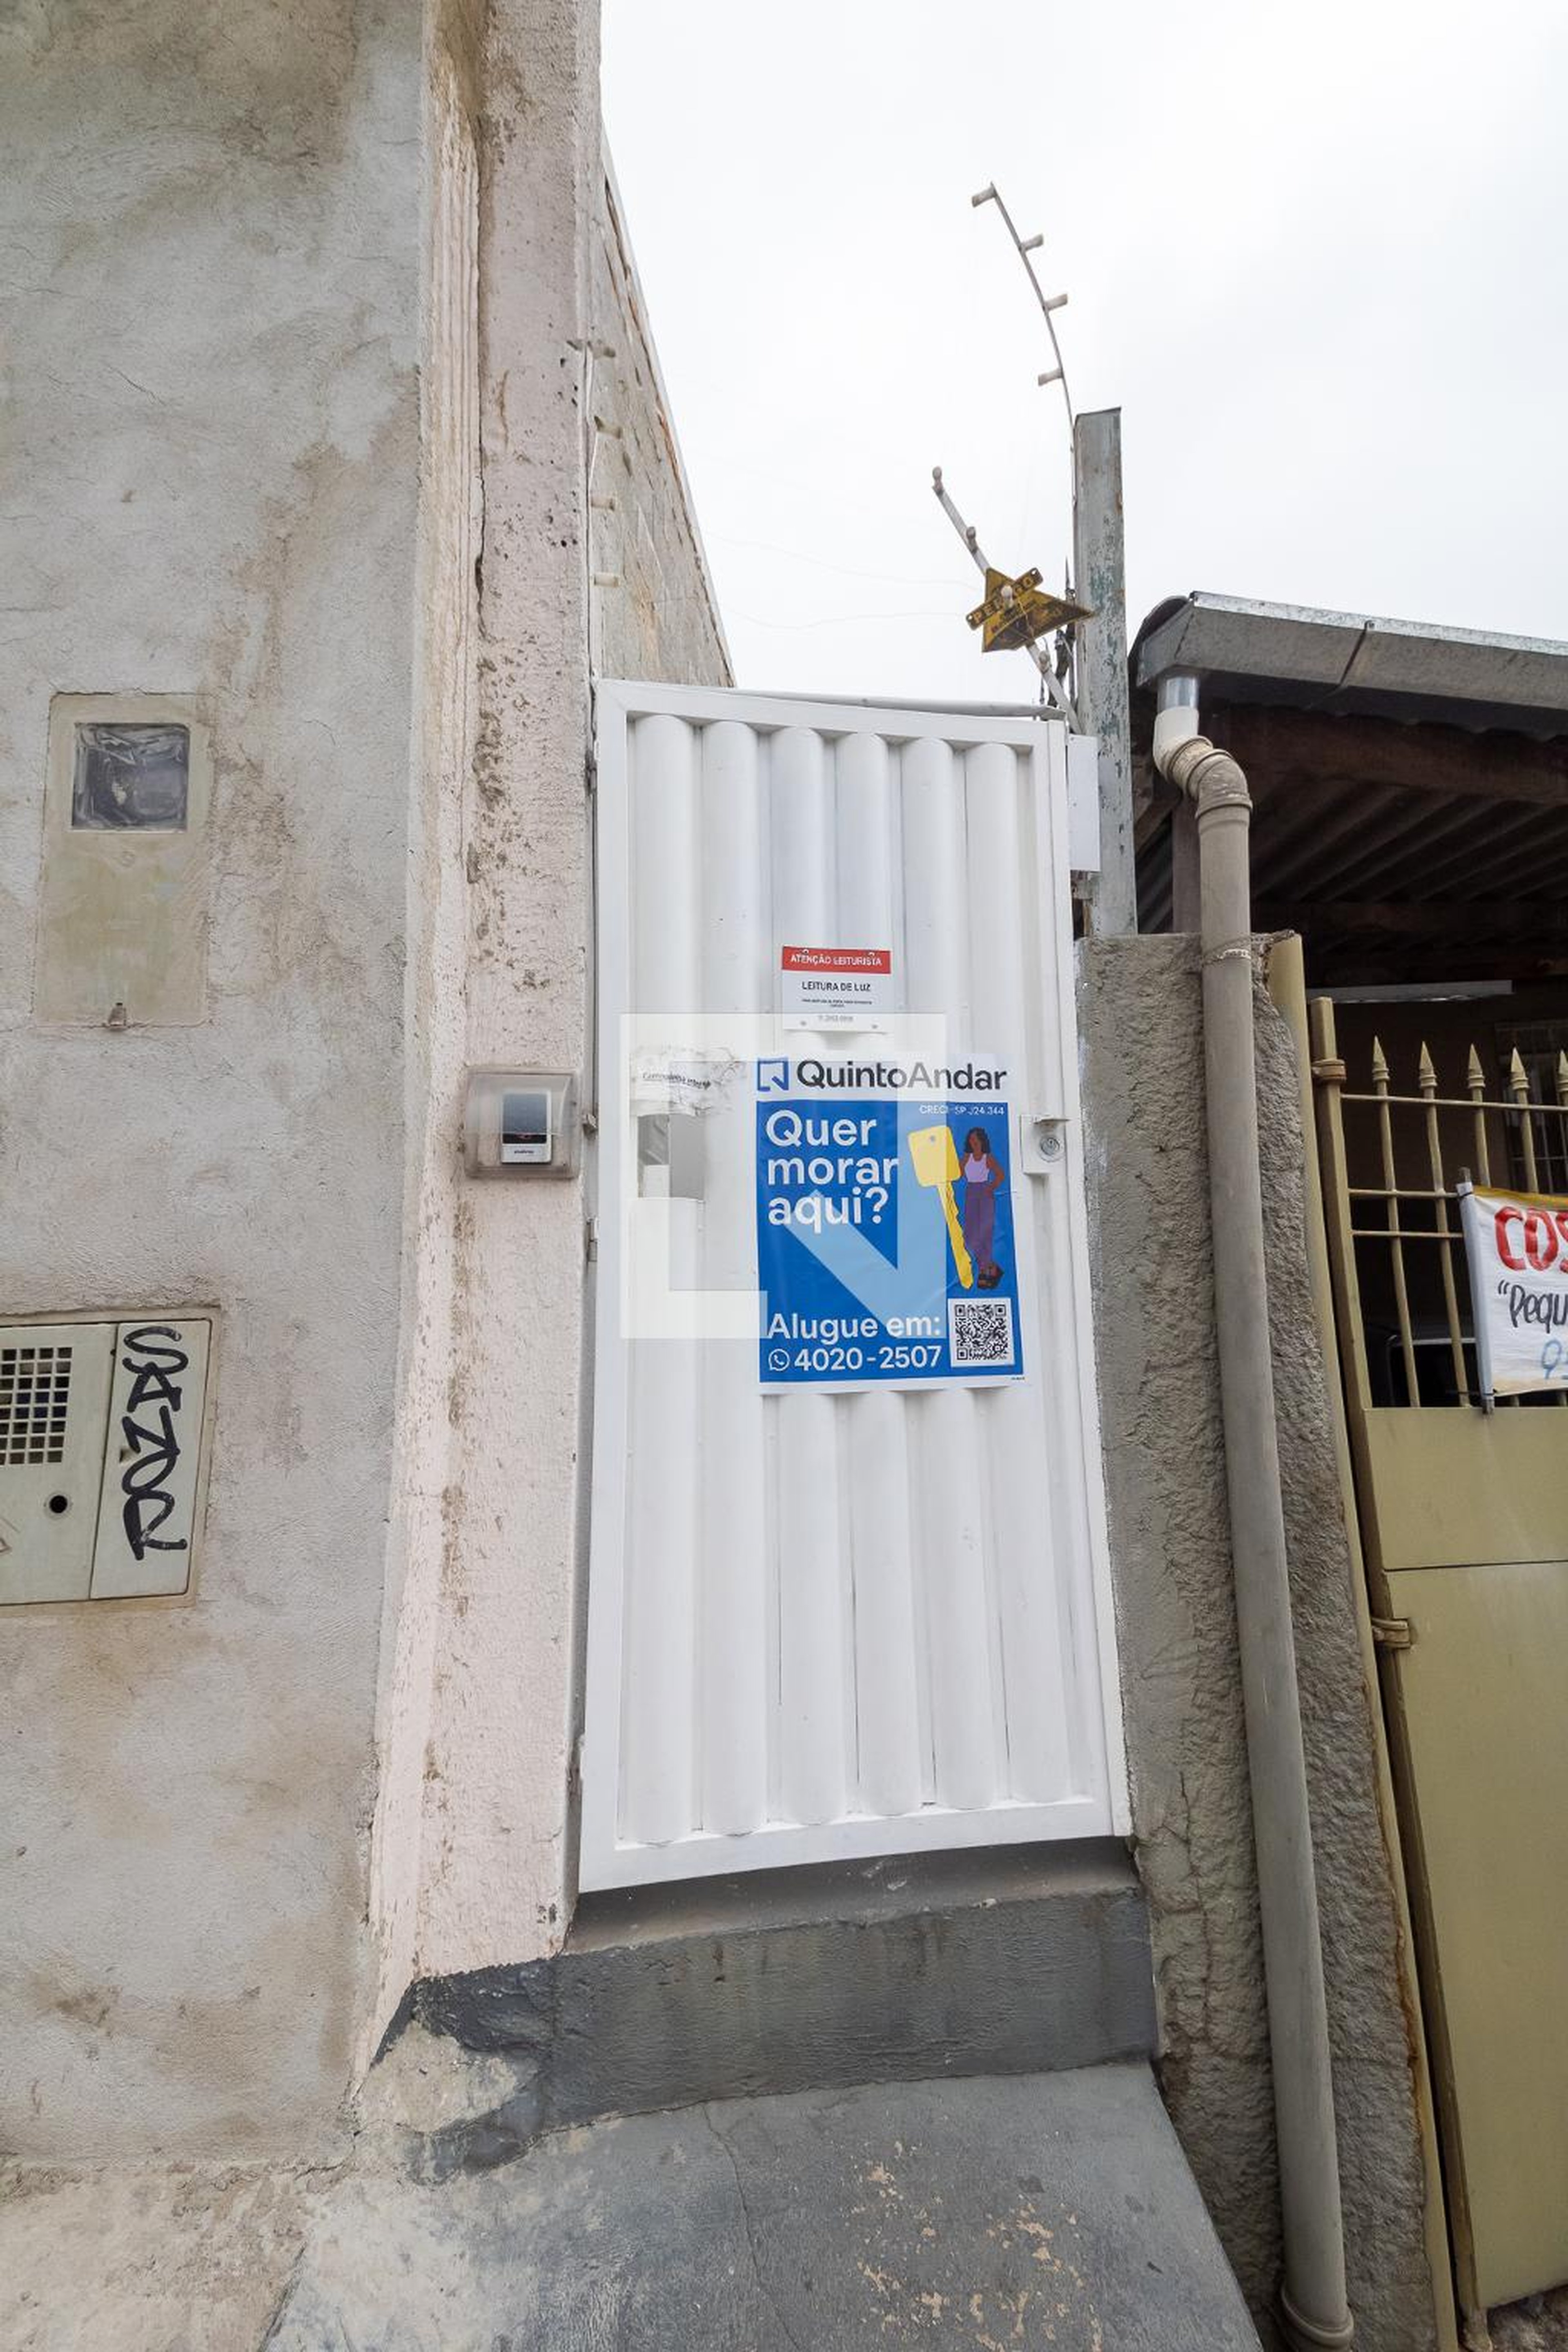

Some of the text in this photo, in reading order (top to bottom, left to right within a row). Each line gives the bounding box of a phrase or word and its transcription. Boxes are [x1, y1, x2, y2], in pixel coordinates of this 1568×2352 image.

[974, 577, 1034, 624] PEGO
[791, 953, 882, 966] ATENÇÃO LEITURISTA
[802, 981, 871, 992] LEITURA DE LUZ
[797, 1060, 1007, 1090] QuintoAndar
[766, 1109, 877, 1147] Quer
[768, 1156, 900, 1185] morar
[768, 1186, 889, 1234] aqui?
[768, 1313, 941, 1345] Alugue em:
